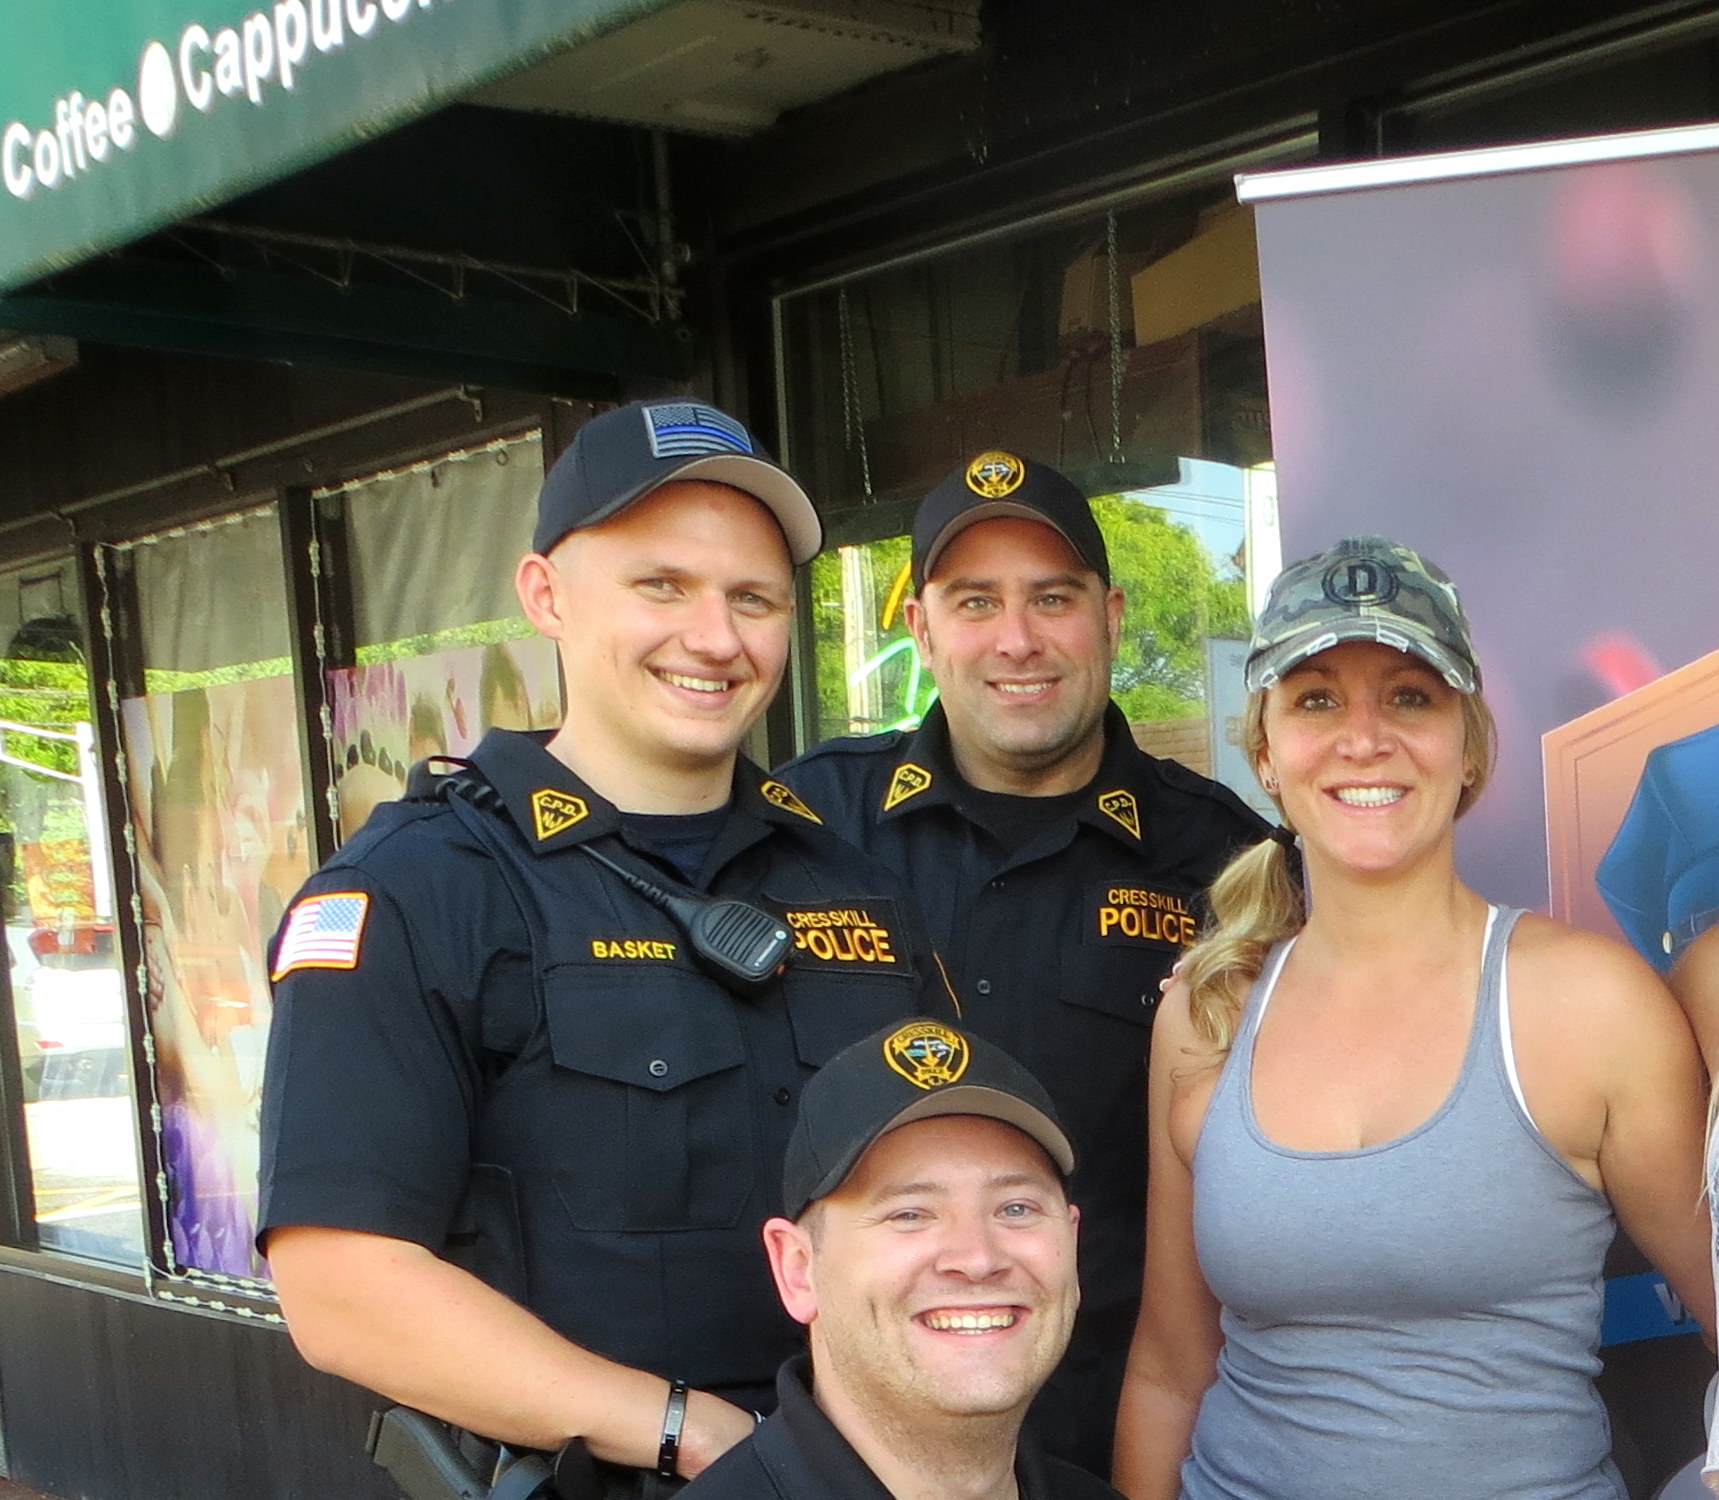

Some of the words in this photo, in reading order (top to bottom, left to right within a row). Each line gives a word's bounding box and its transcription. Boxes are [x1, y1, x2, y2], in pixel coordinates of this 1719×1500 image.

[2, 89, 136, 199] Coffee
[180, 0, 432, 112] Cappuc
[1108, 889, 1188, 914] CRESSKILL
[787, 910, 877, 928] CRESSKILL
[1100, 907, 1196, 947] POLICE
[591, 939, 677, 961] BASKET
